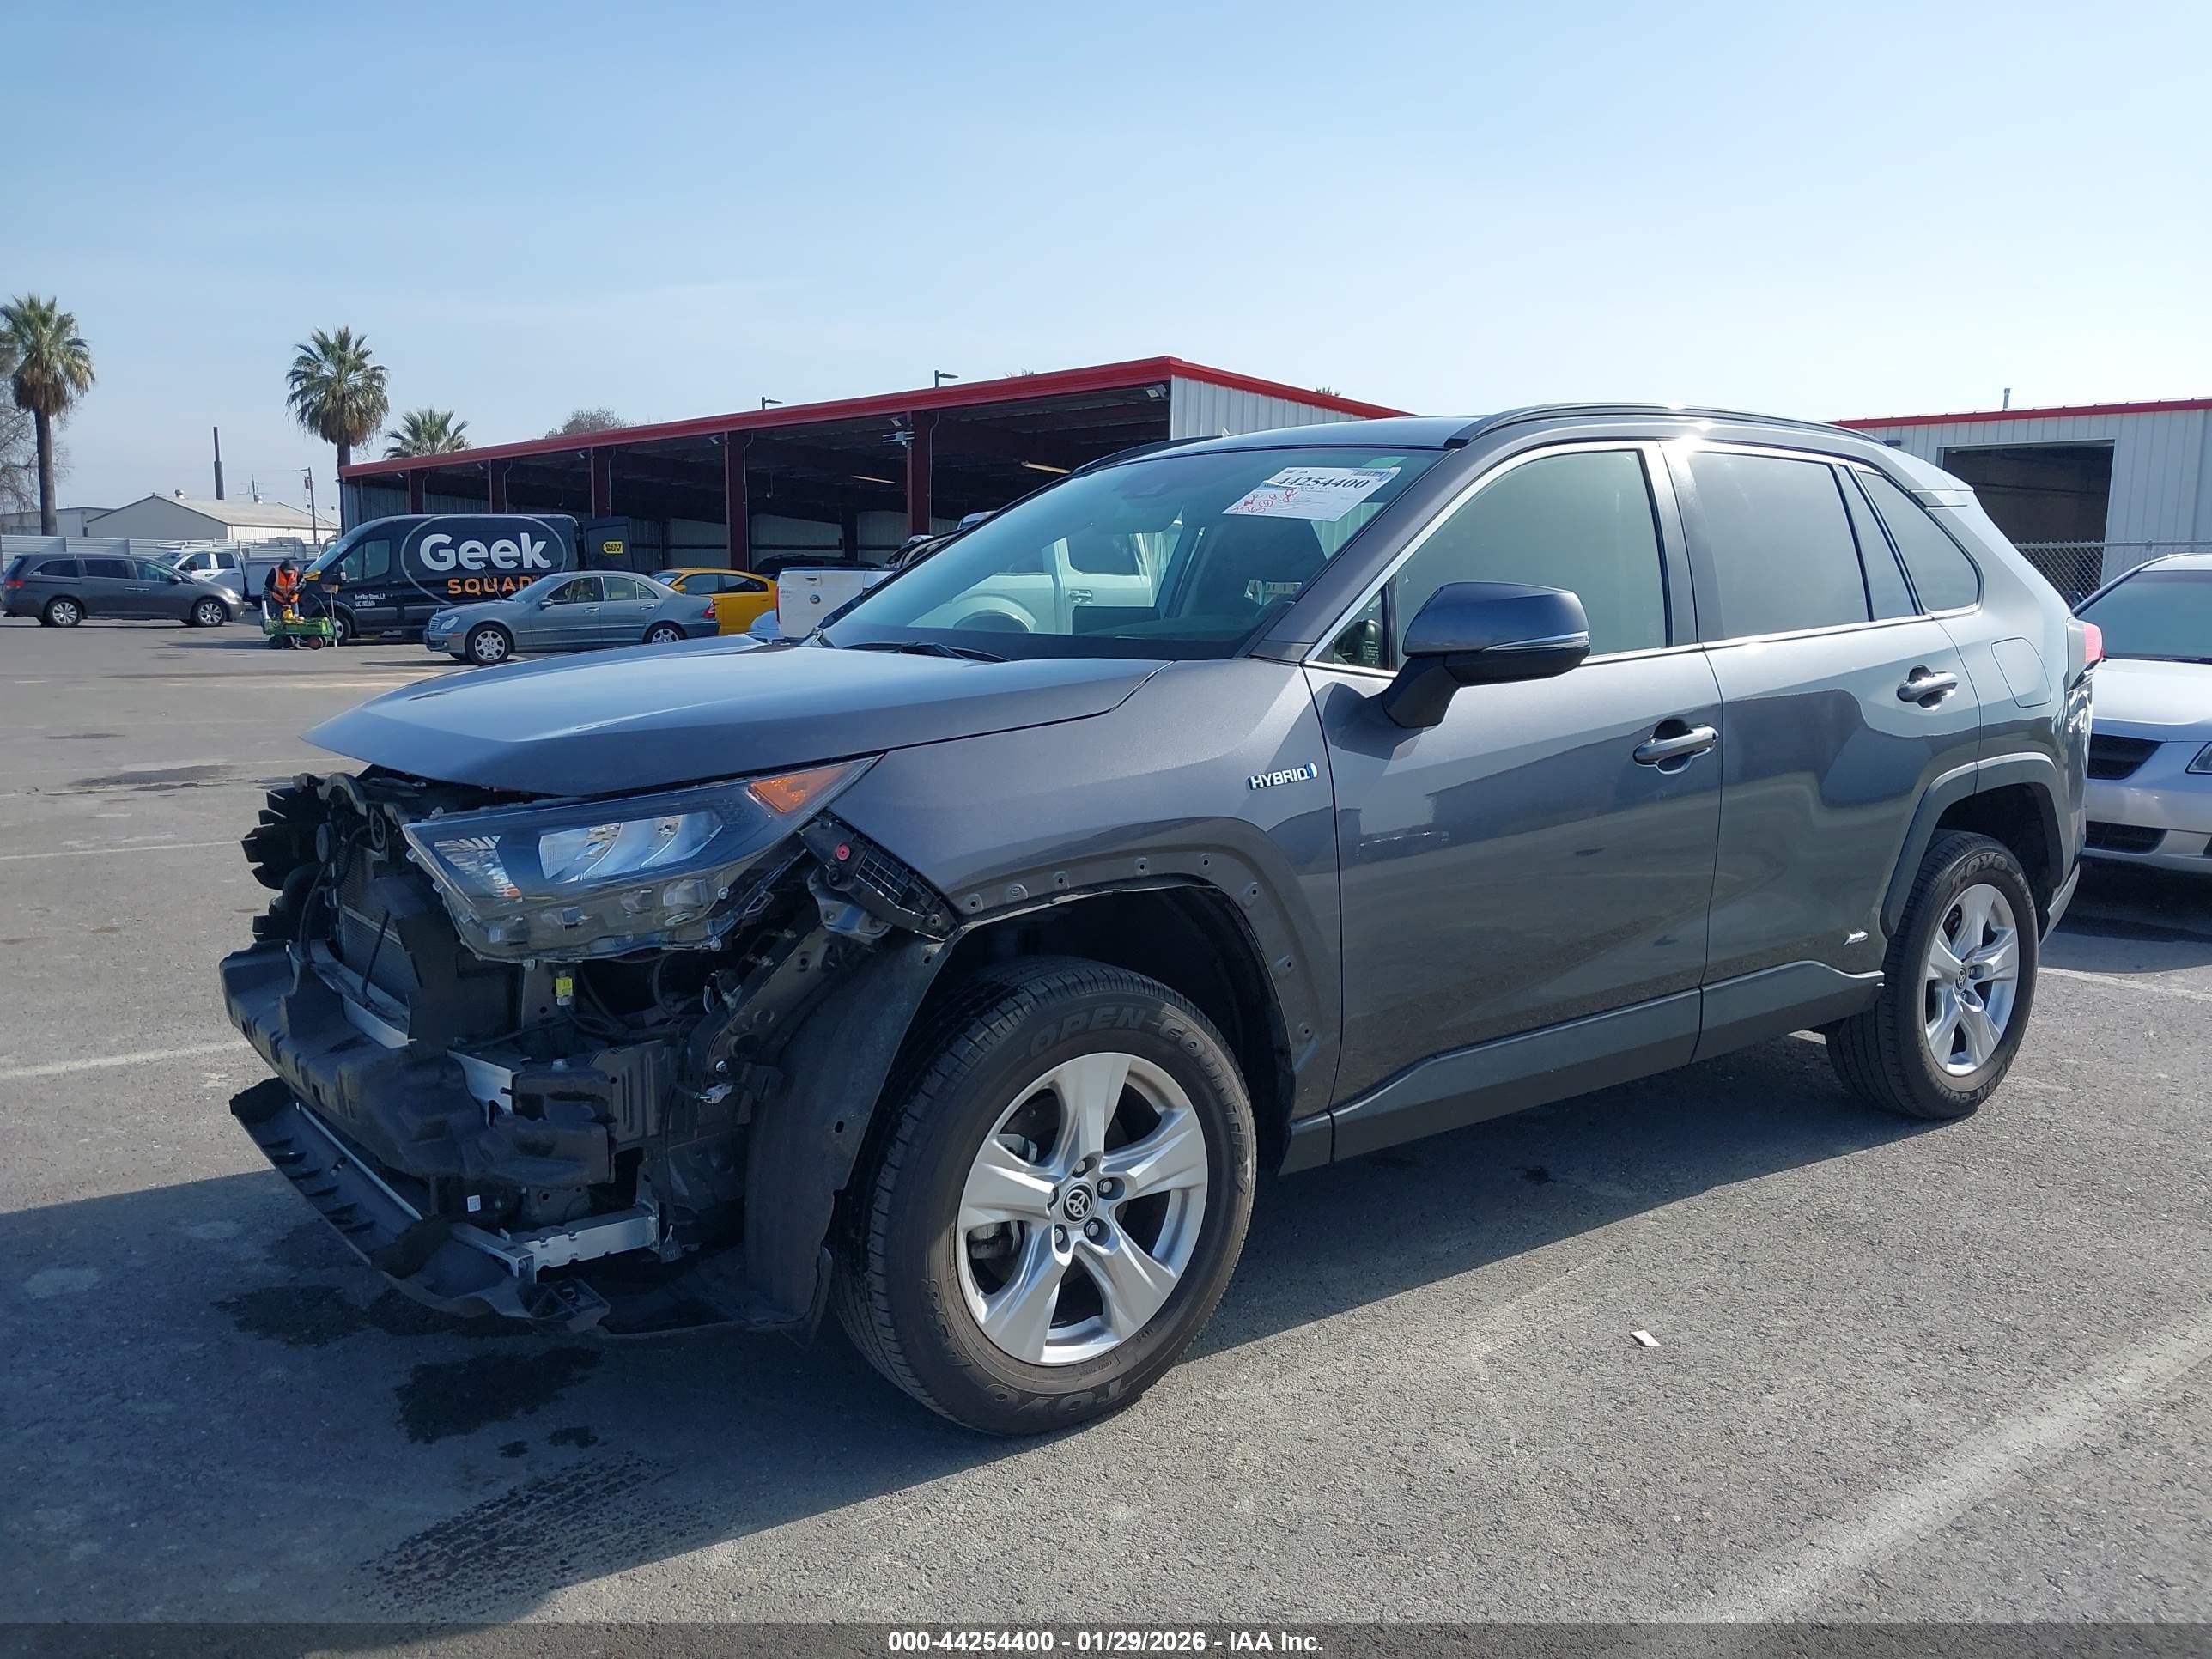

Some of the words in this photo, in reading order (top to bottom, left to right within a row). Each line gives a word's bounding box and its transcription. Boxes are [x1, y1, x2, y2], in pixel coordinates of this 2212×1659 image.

[1277, 477, 1370, 489] 44254400
[420, 532, 552, 572] Geek
[447, 576, 532, 596] SQUAD
[1250, 768, 1310, 789] HYBRID
[1952, 854, 2008, 886] TOYO
[1030, 1006, 1148, 1057] OPEN
[1158, 1018, 1249, 1195] COUNTRY
[982, 1378, 1131, 1417] TOYO
